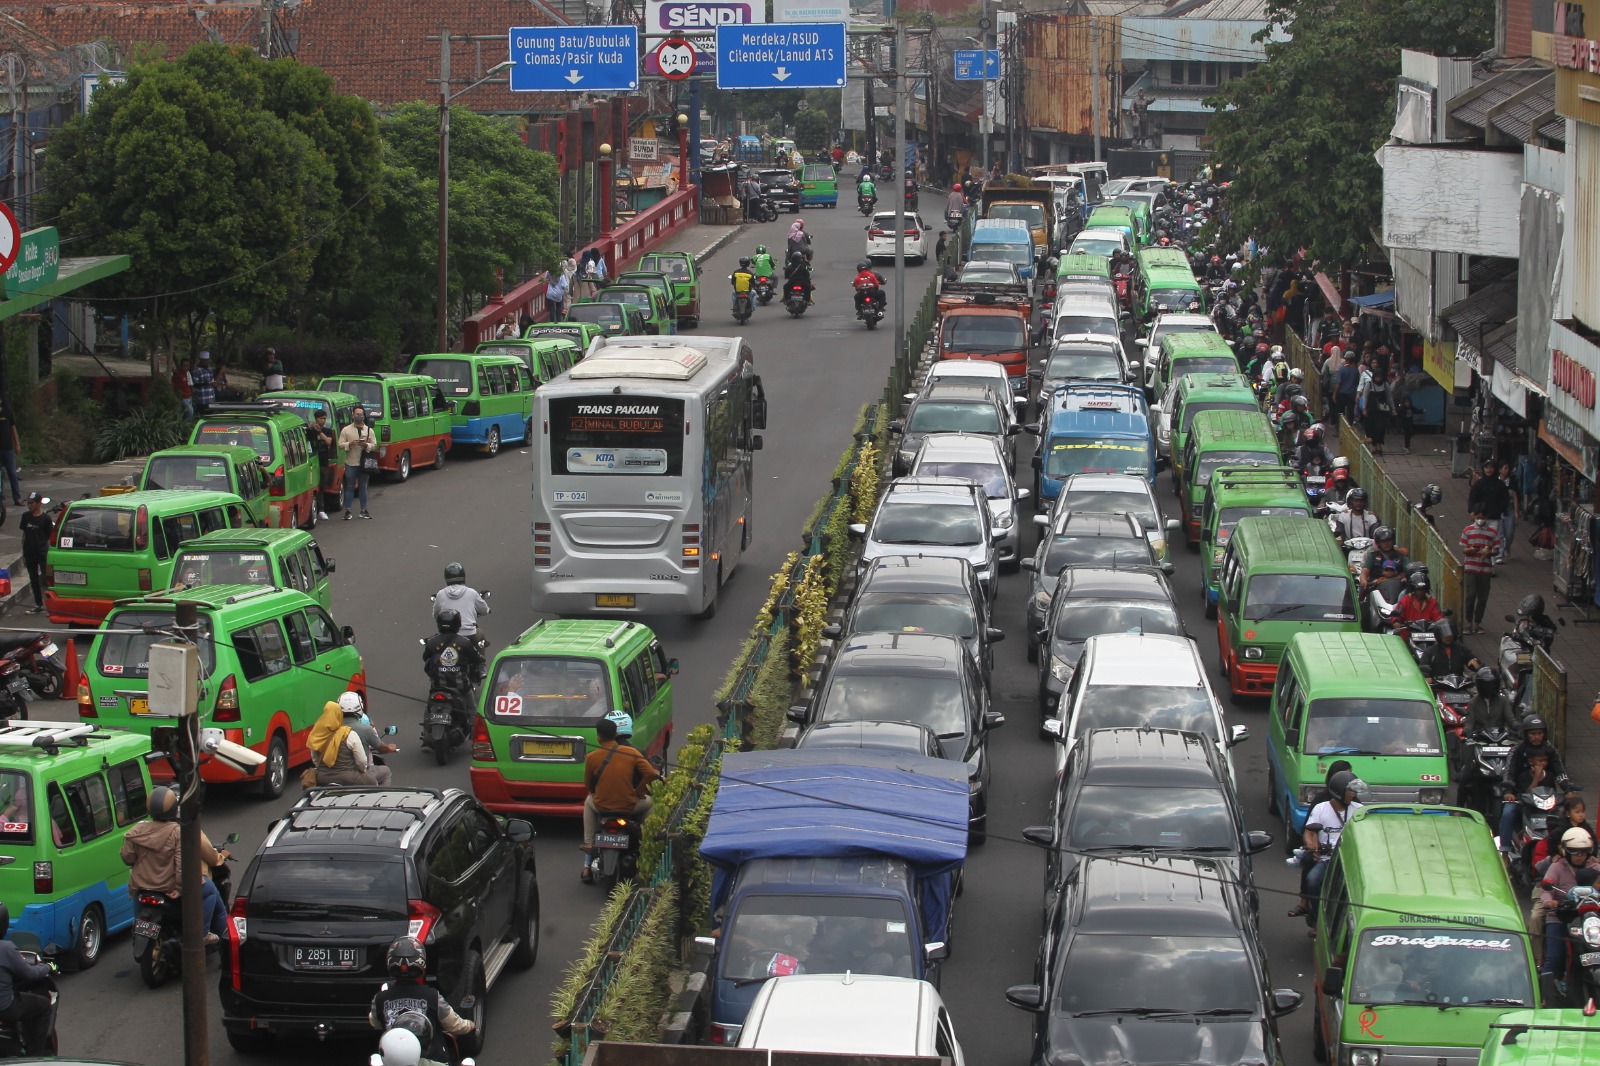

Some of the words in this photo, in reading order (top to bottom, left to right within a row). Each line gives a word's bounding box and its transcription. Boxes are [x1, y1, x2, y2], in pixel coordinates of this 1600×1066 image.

[668, 4, 743, 27] SÉNDI
[516, 36, 555, 51] Gunung
[560, 34, 631, 49] Batu/Bubulak
[742, 32, 819, 46] Merdeka/RSUD
[525, 51, 594, 66] Ciomas/Pasir
[598, 51, 623, 64] Kuda
[662, 54, 678, 67] 4,2
[680, 57, 690, 65] m
[728, 48, 811, 63] Cilendek/Lanud
[814, 48, 834, 61] ATS
[633, 145, 654, 153] SUNDA
[577, 405, 613, 414] TRANS
[614, 405, 660, 415] PAKUAN
[555, 492, 564, 500] TP
[570, 492, 586, 500] 024
[62, 538, 71, 546] 02
[497, 697, 521, 713] 02
[1399, 914, 1441, 924] SUKASARI
[1447, 915, 1485, 925] LALADON
[296, 949, 303, 960] B
[308, 949, 330, 960] 2851
[338, 949, 356, 960] TBT
[1358, 1009, 1385, 1039] R
